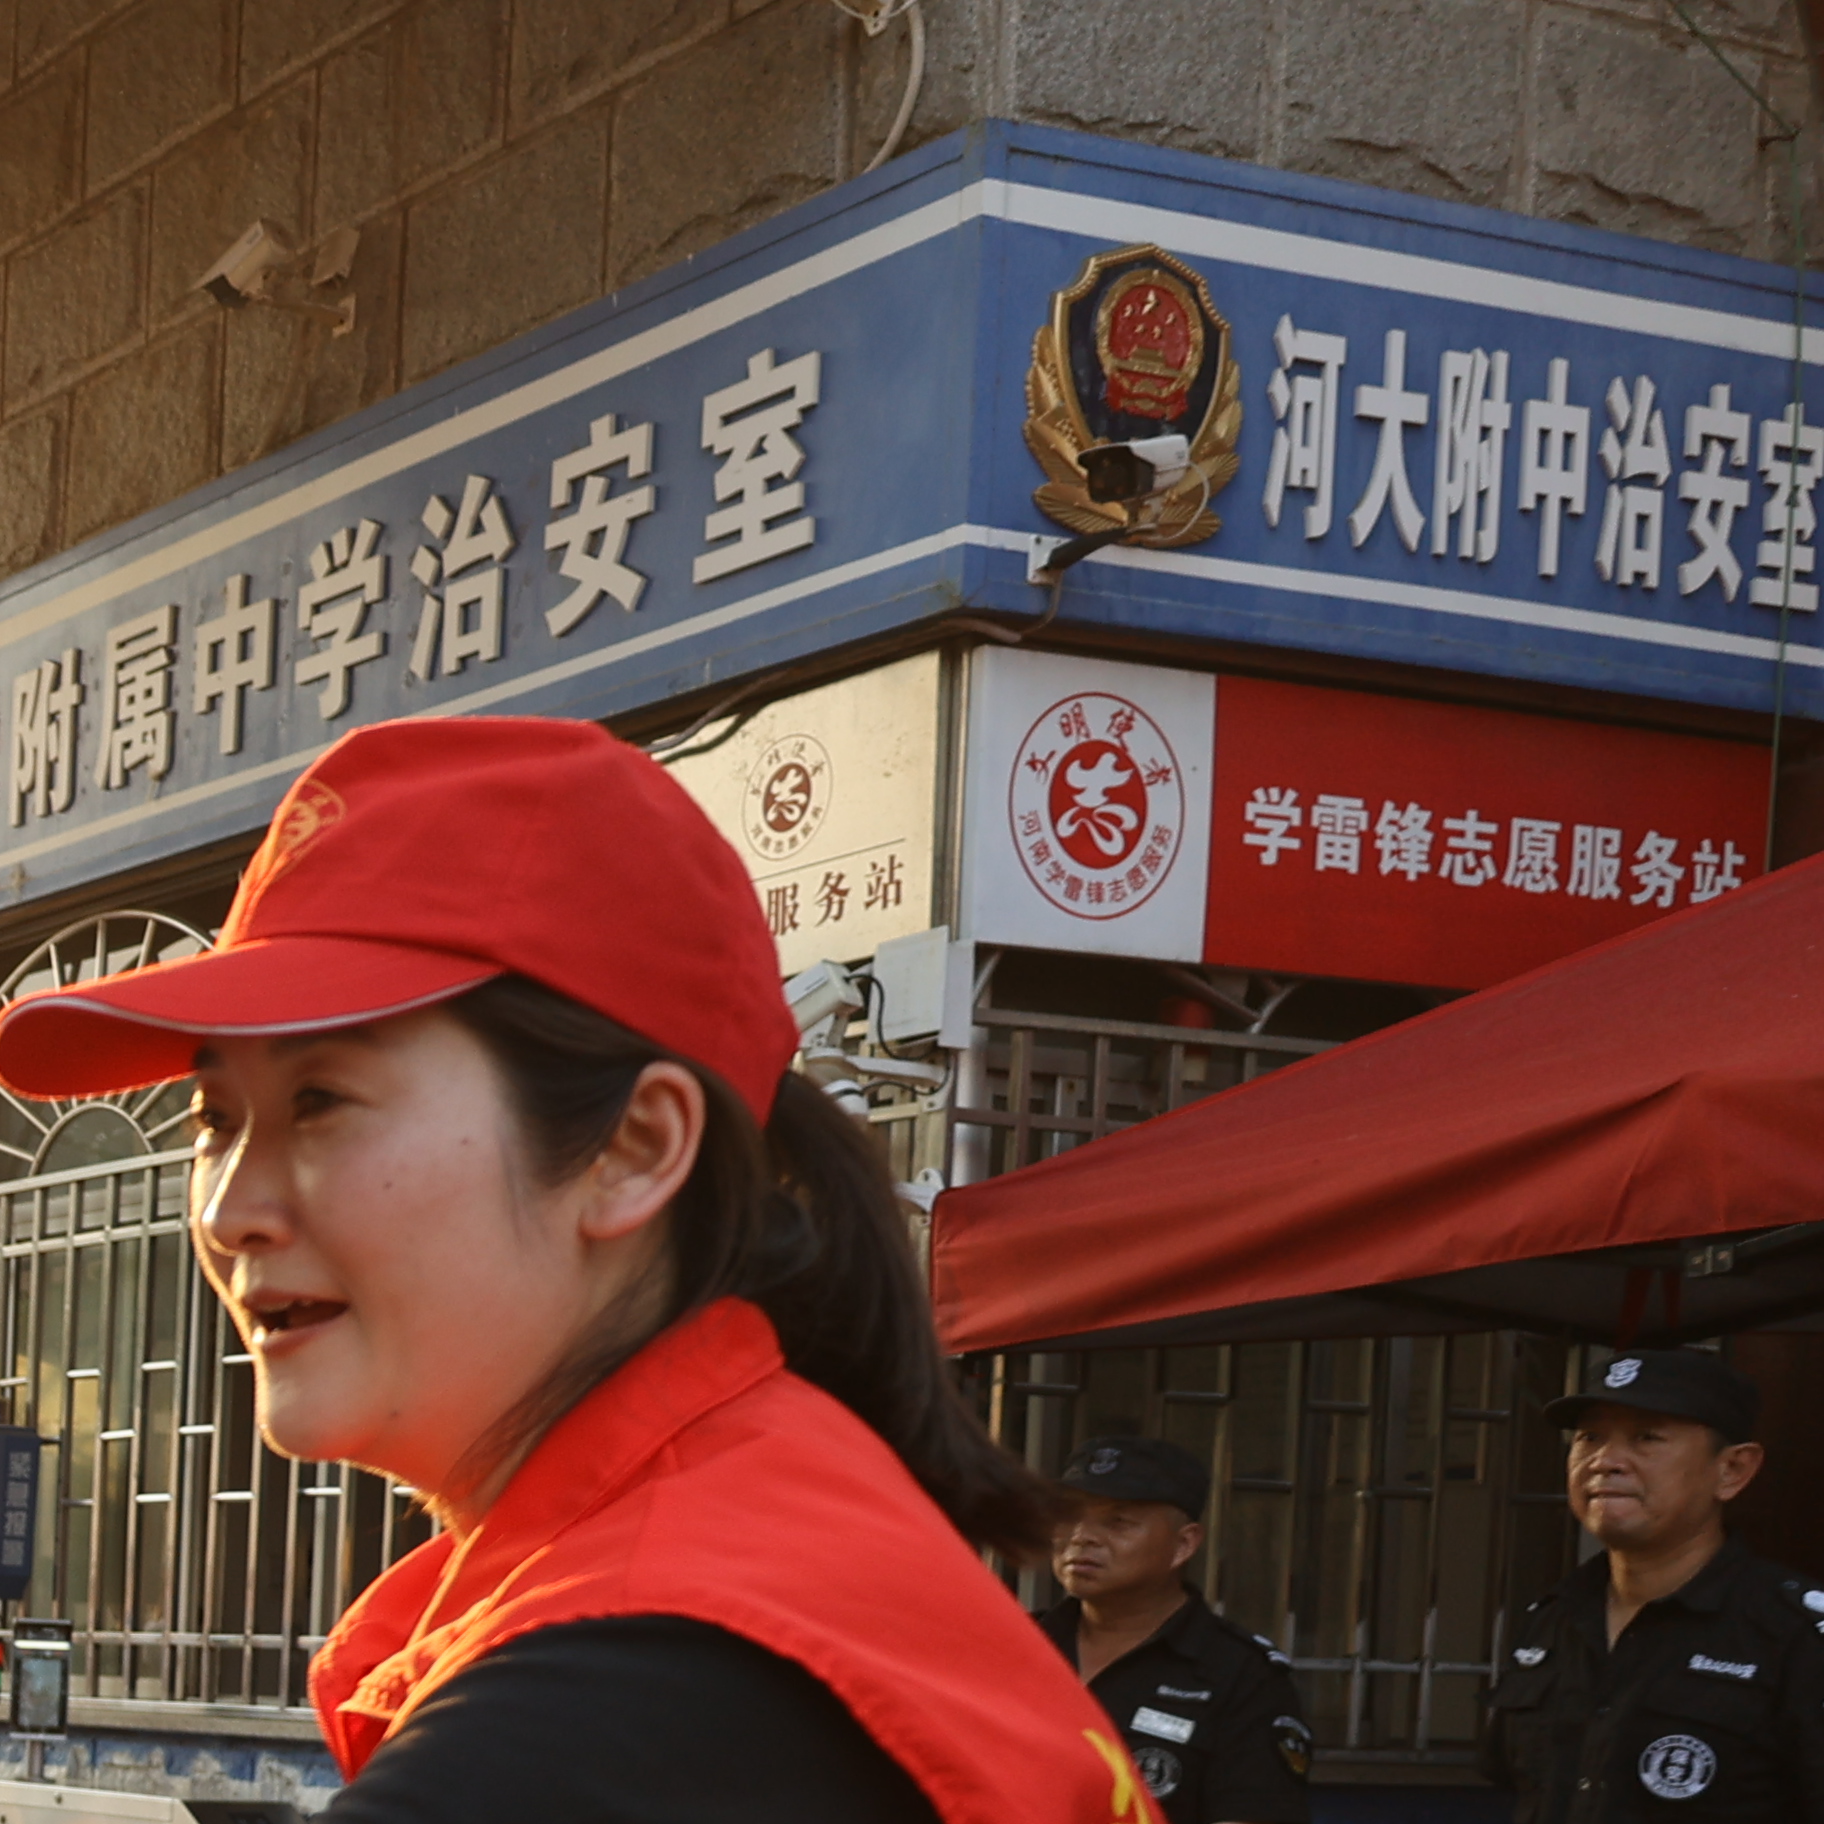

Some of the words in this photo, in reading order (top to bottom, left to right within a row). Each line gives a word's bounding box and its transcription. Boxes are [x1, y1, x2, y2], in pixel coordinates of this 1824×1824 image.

[1262, 312, 1824, 614] 河大附中治安室
[766, 854, 904, 937] 服务站
[1241, 785, 1747, 910] 学雷锋志愿服务站
